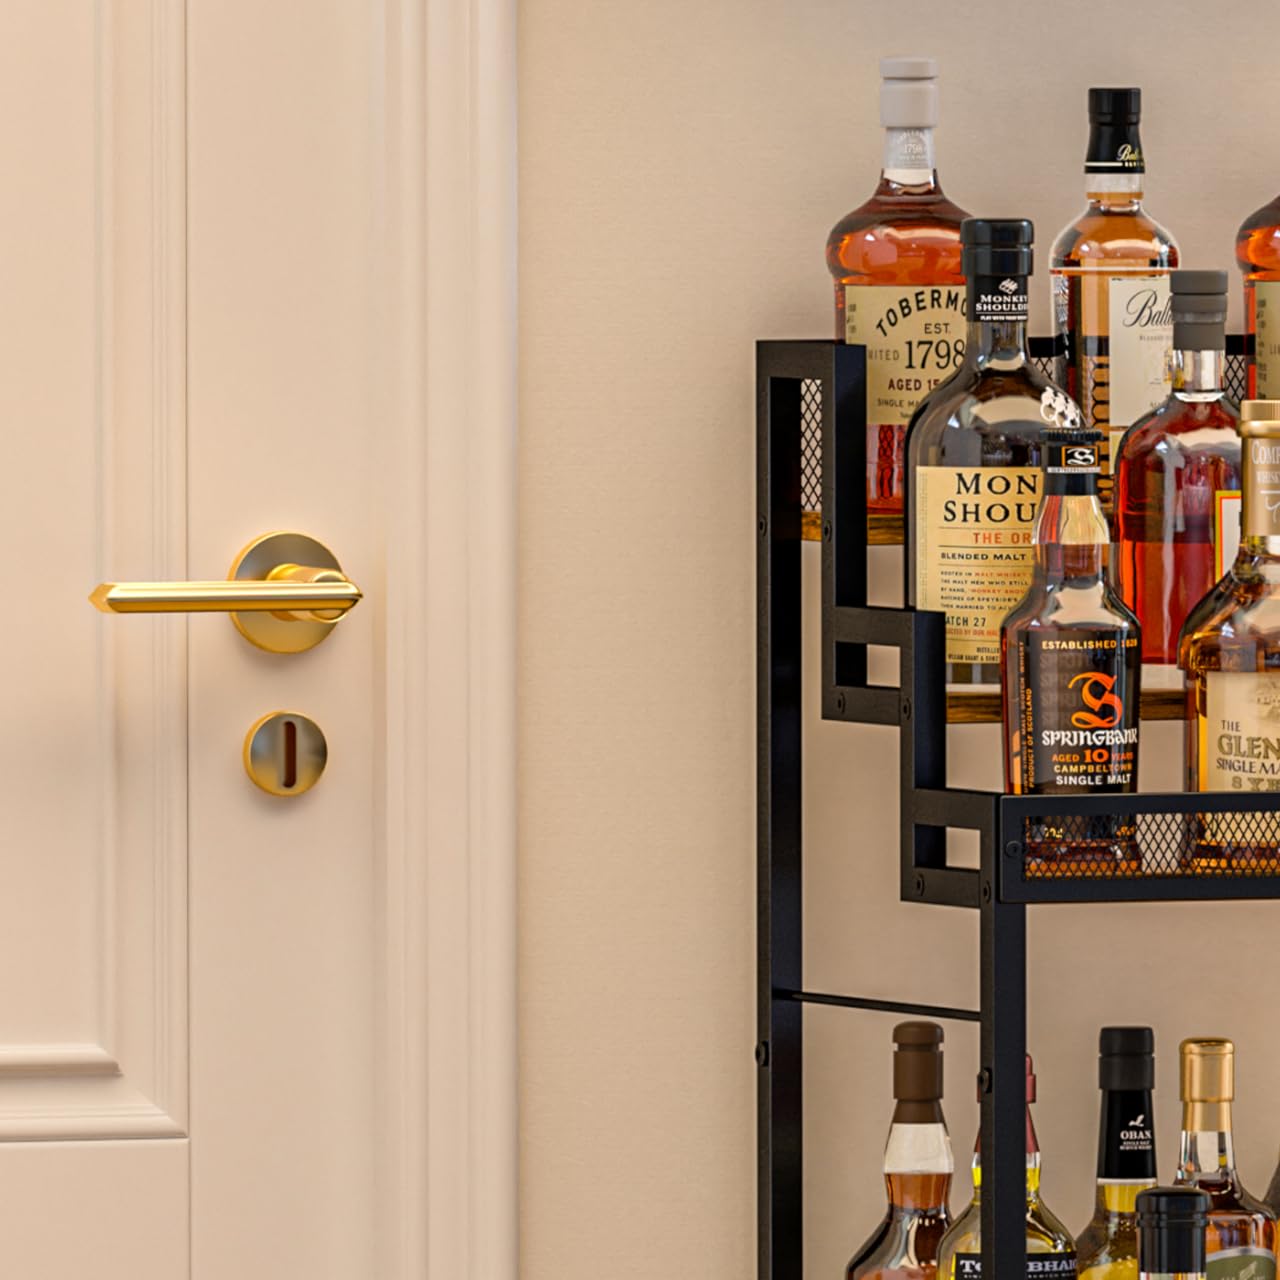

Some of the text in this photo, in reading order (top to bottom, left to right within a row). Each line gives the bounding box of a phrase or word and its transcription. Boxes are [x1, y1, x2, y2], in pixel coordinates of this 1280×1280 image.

[905, 340, 965, 369] 1798
[888, 379, 922, 391] AGED
[956, 473, 1037, 494] MON
[973, 533, 1002, 544] THE
[941, 552, 988, 560] BLENDED
[973, 617, 986, 627] 27
[1042, 640, 1116, 650] ESTABLISHED
[1221, 719, 1241, 732] THE
[1028, 736, 1034, 745] OF
[1052, 753, 1080, 762] AGED
[1083, 748, 1109, 763] 10
[1054, 763, 1132, 773] CAMPBELTOWN
[1216, 758, 1257, 774] SINGLE
[1056, 773, 1131, 785] SINGLE MALT
[1231, 776, 1242, 789] 8
[960, 1260, 1076, 1272] TOBHAI
